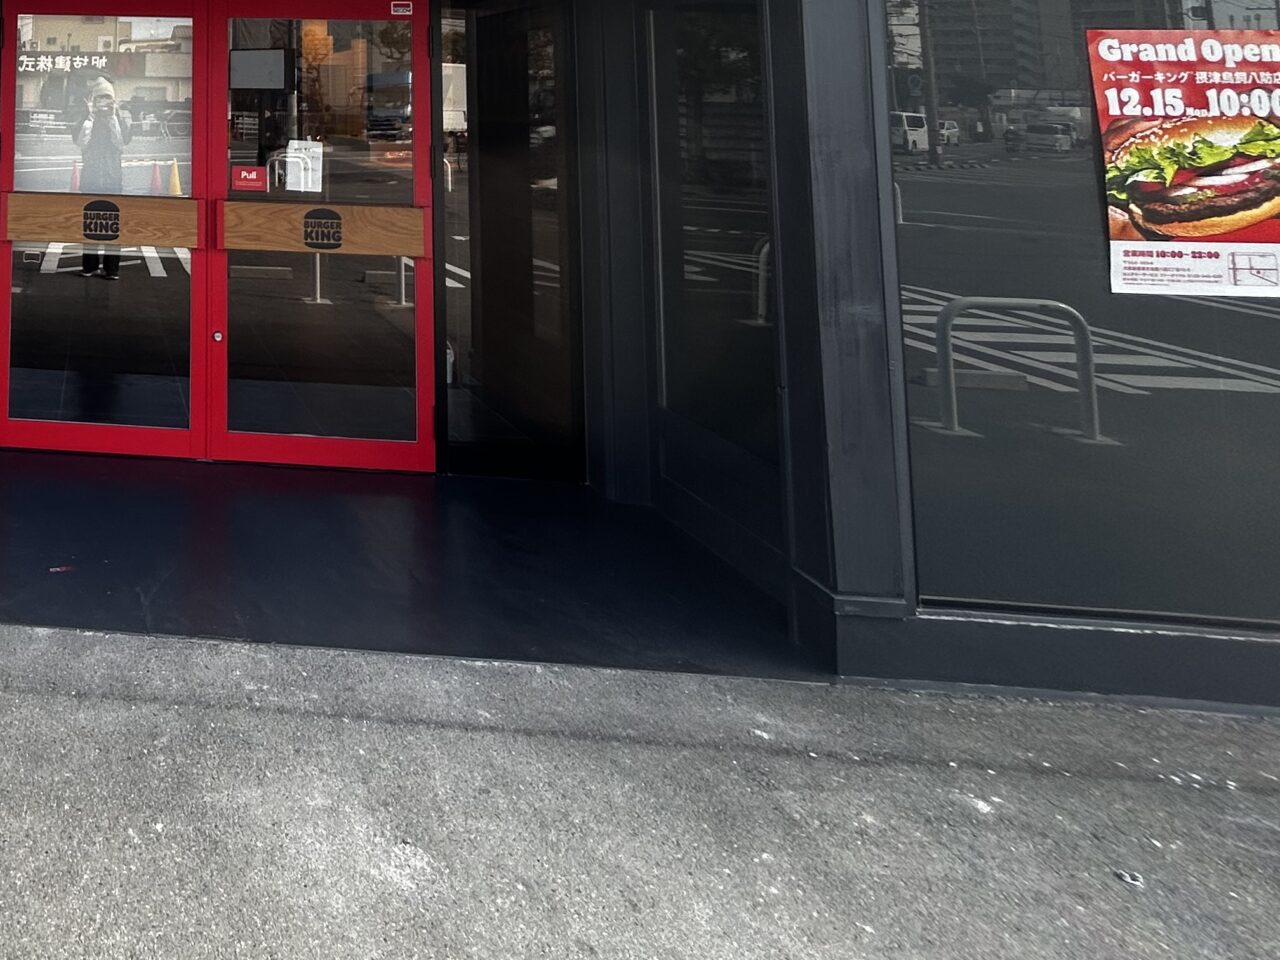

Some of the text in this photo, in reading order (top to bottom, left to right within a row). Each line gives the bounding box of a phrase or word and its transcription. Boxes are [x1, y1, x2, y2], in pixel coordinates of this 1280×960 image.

[1098, 38, 1280, 67] Grand Open
[1103, 71, 1189, 84] バーガーキング
[1105, 87, 1184, 116] 12.15
[241, 171, 257, 179] Pull
[83, 212, 120, 221] BURGER
[83, 221, 120, 233] KING
[304, 221, 342, 230] BURGER
[304, 229, 342, 242] KING
